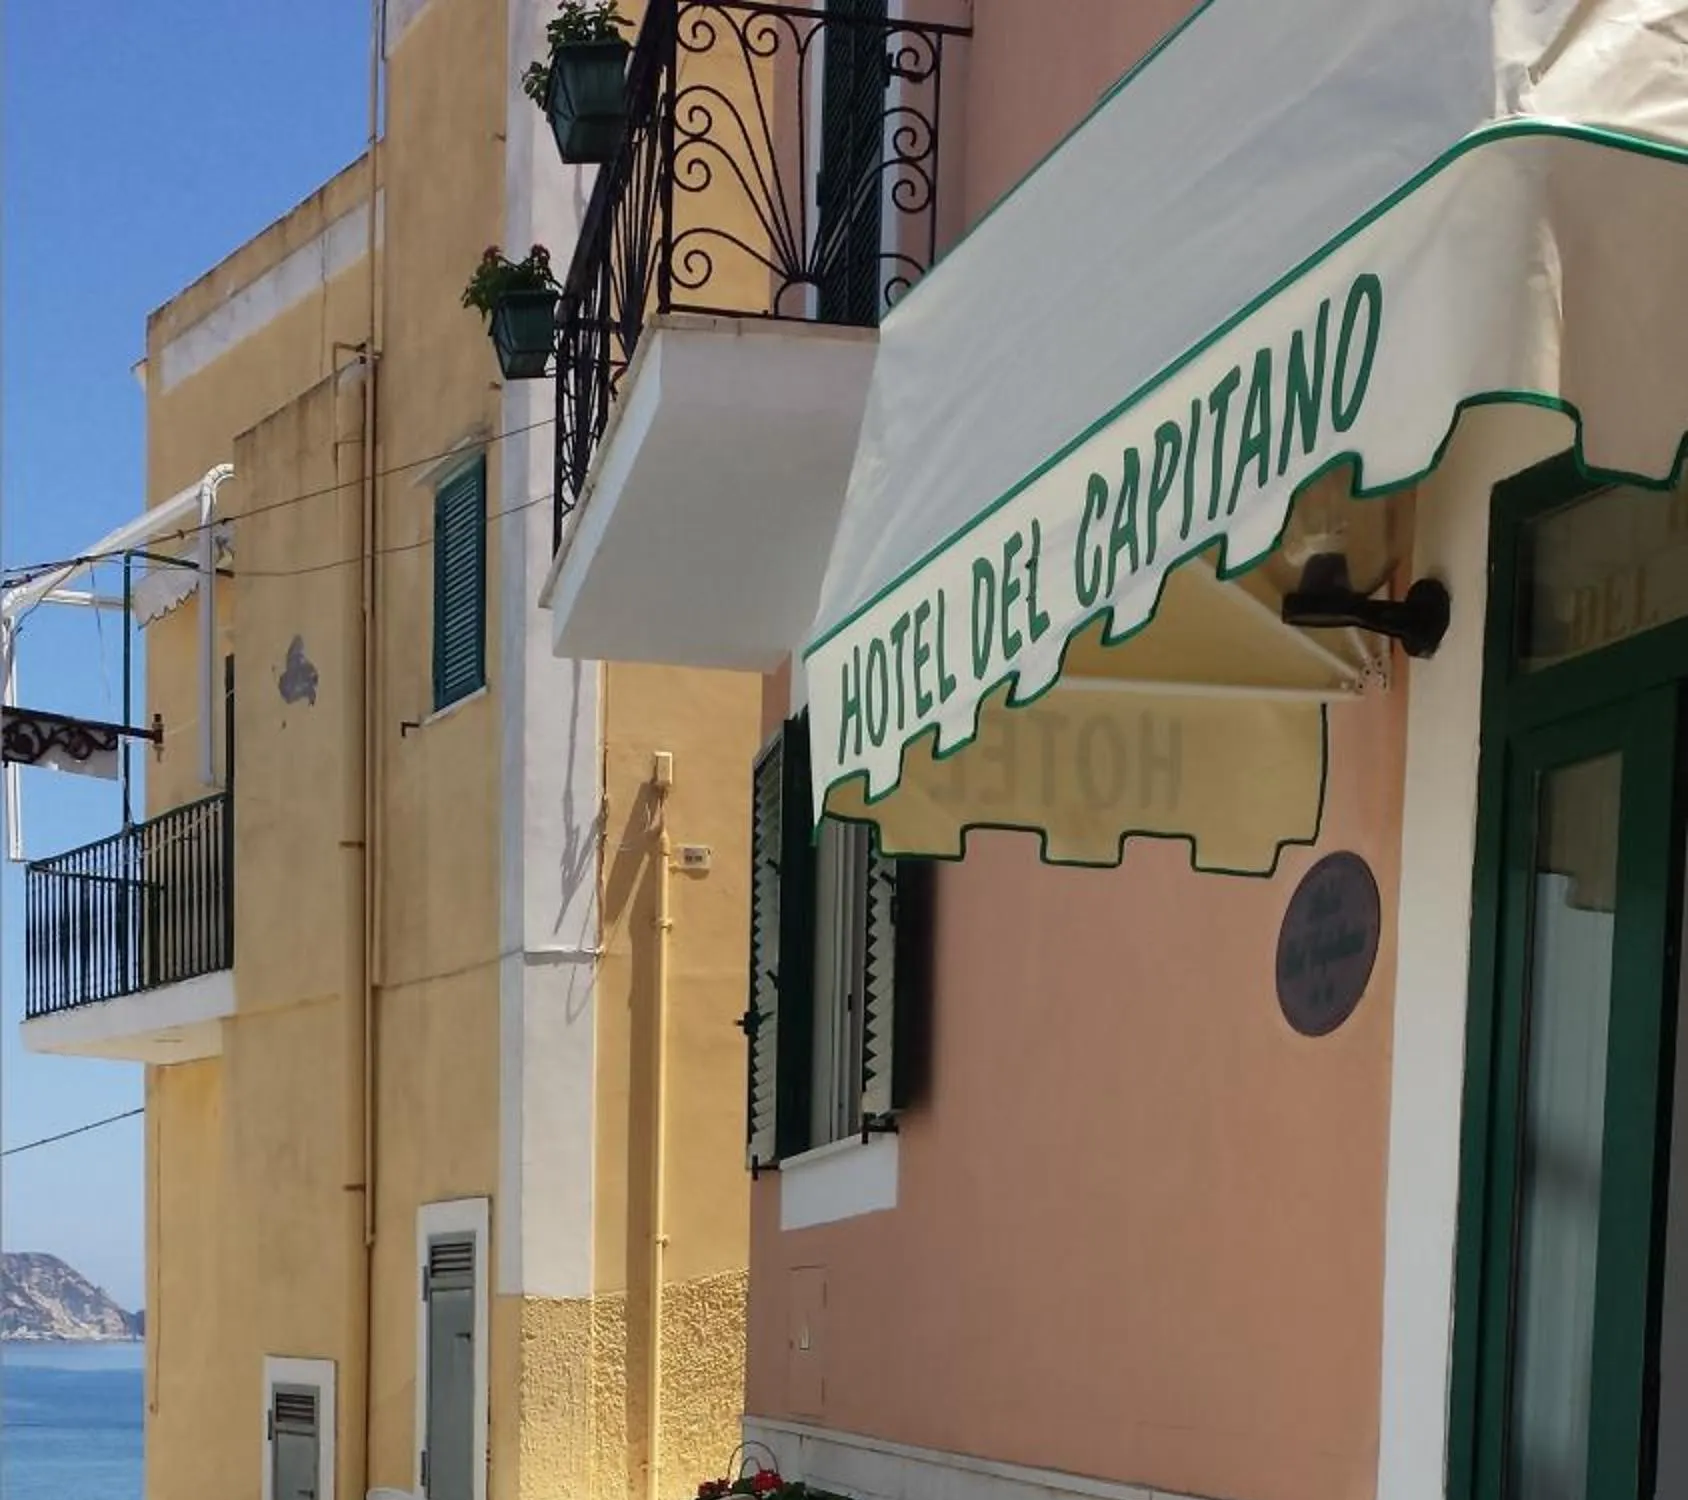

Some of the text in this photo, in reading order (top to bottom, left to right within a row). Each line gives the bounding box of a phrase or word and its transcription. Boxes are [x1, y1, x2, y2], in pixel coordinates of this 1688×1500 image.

[838, 273, 1383, 764] HOTEL DEL CAPITANO
